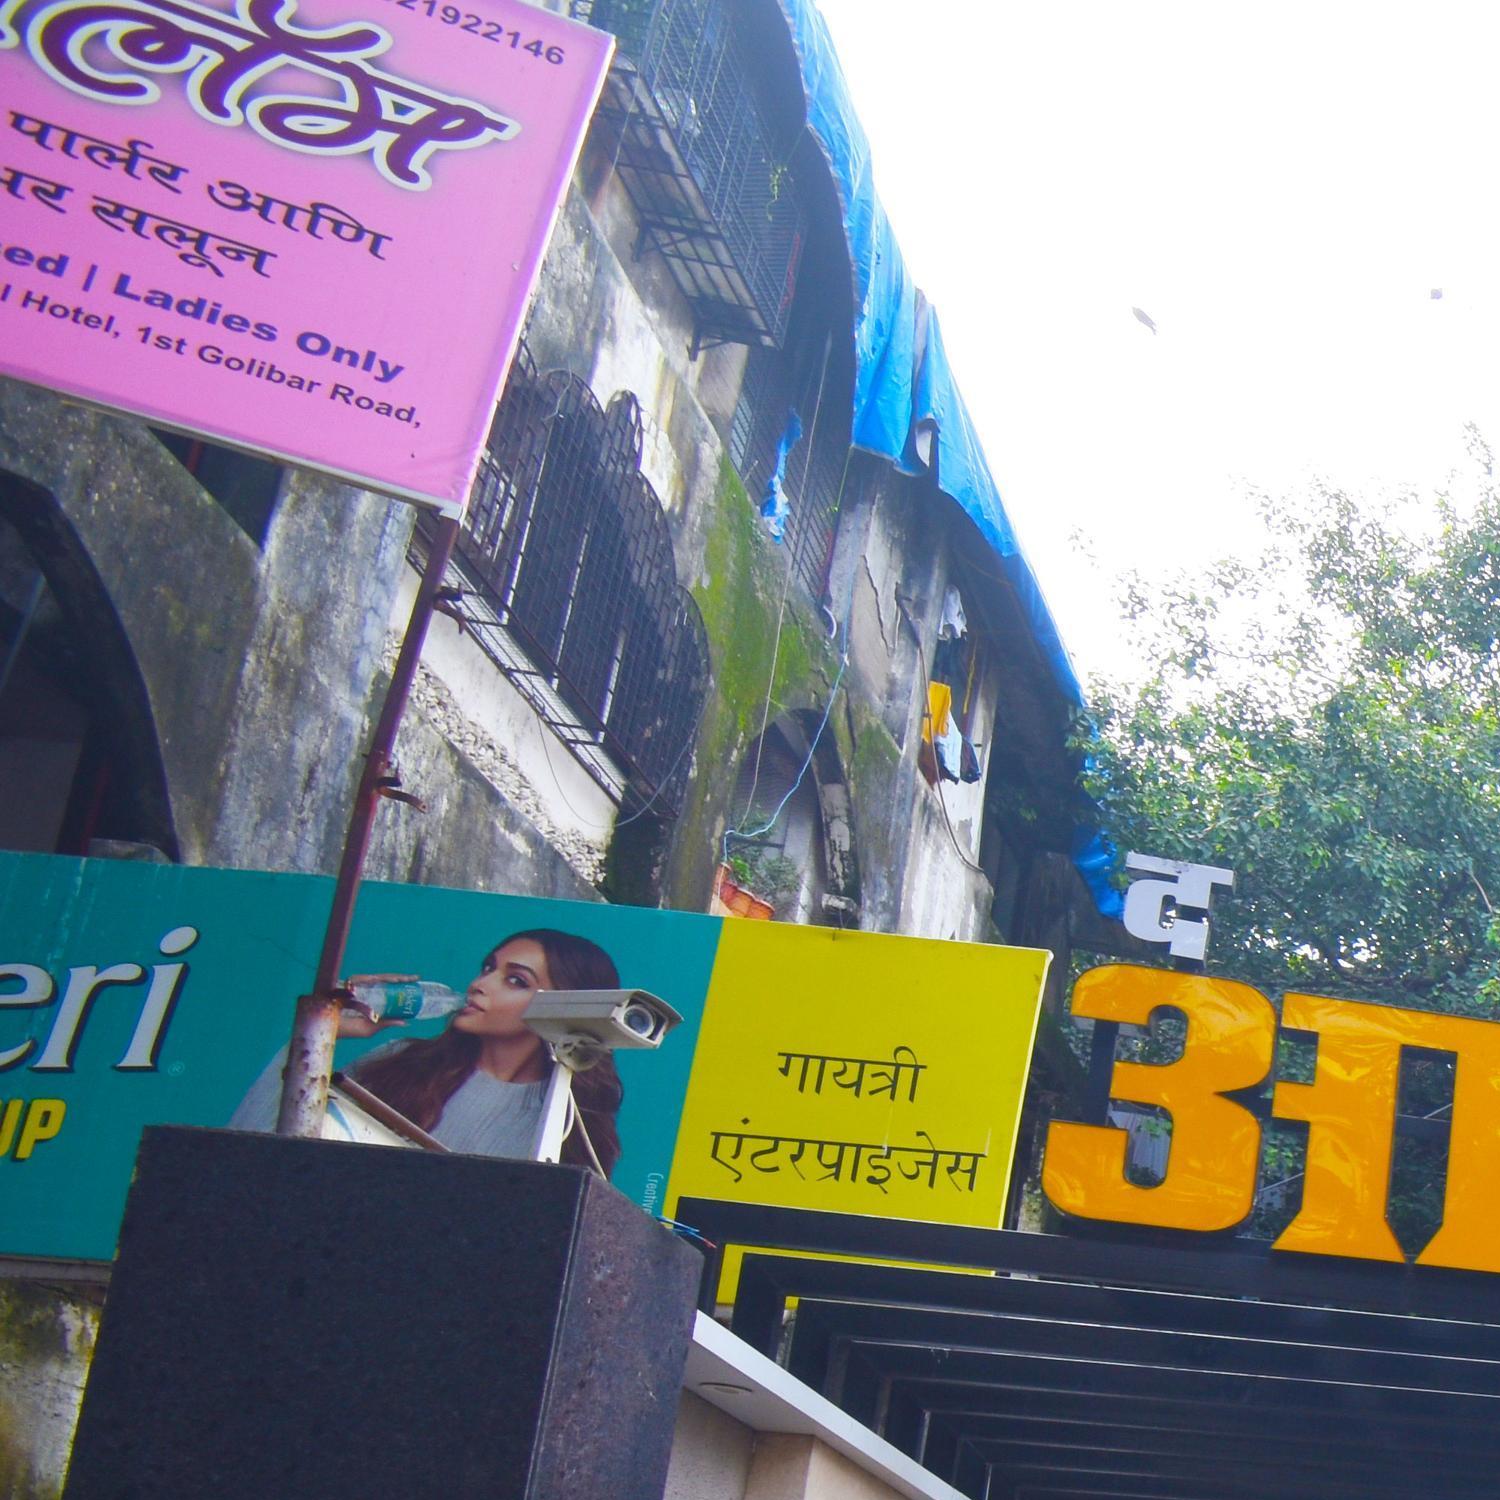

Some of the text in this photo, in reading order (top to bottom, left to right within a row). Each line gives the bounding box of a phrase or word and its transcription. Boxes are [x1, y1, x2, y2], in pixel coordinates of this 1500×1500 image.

[383, 0, 566, 65] 21922146
[9, 110, 394, 261] पार्लर आणि
[91, 195, 278, 279] सलून
[0, 242, 70, 278] ed
[113, 272, 279, 344] Ladies
[296, 331, 406, 384] Only
[21, 289, 121, 339] Hotel,
[138, 325, 189, 355] 1st
[197, 344, 322, 394] Golibar
[329, 383, 422, 430] Road,
[1122, 851, 1235, 961] द
[777, 1045, 928, 1104] गायत्री
[710, 1117, 988, 1195] एंटरप्राइजेस
